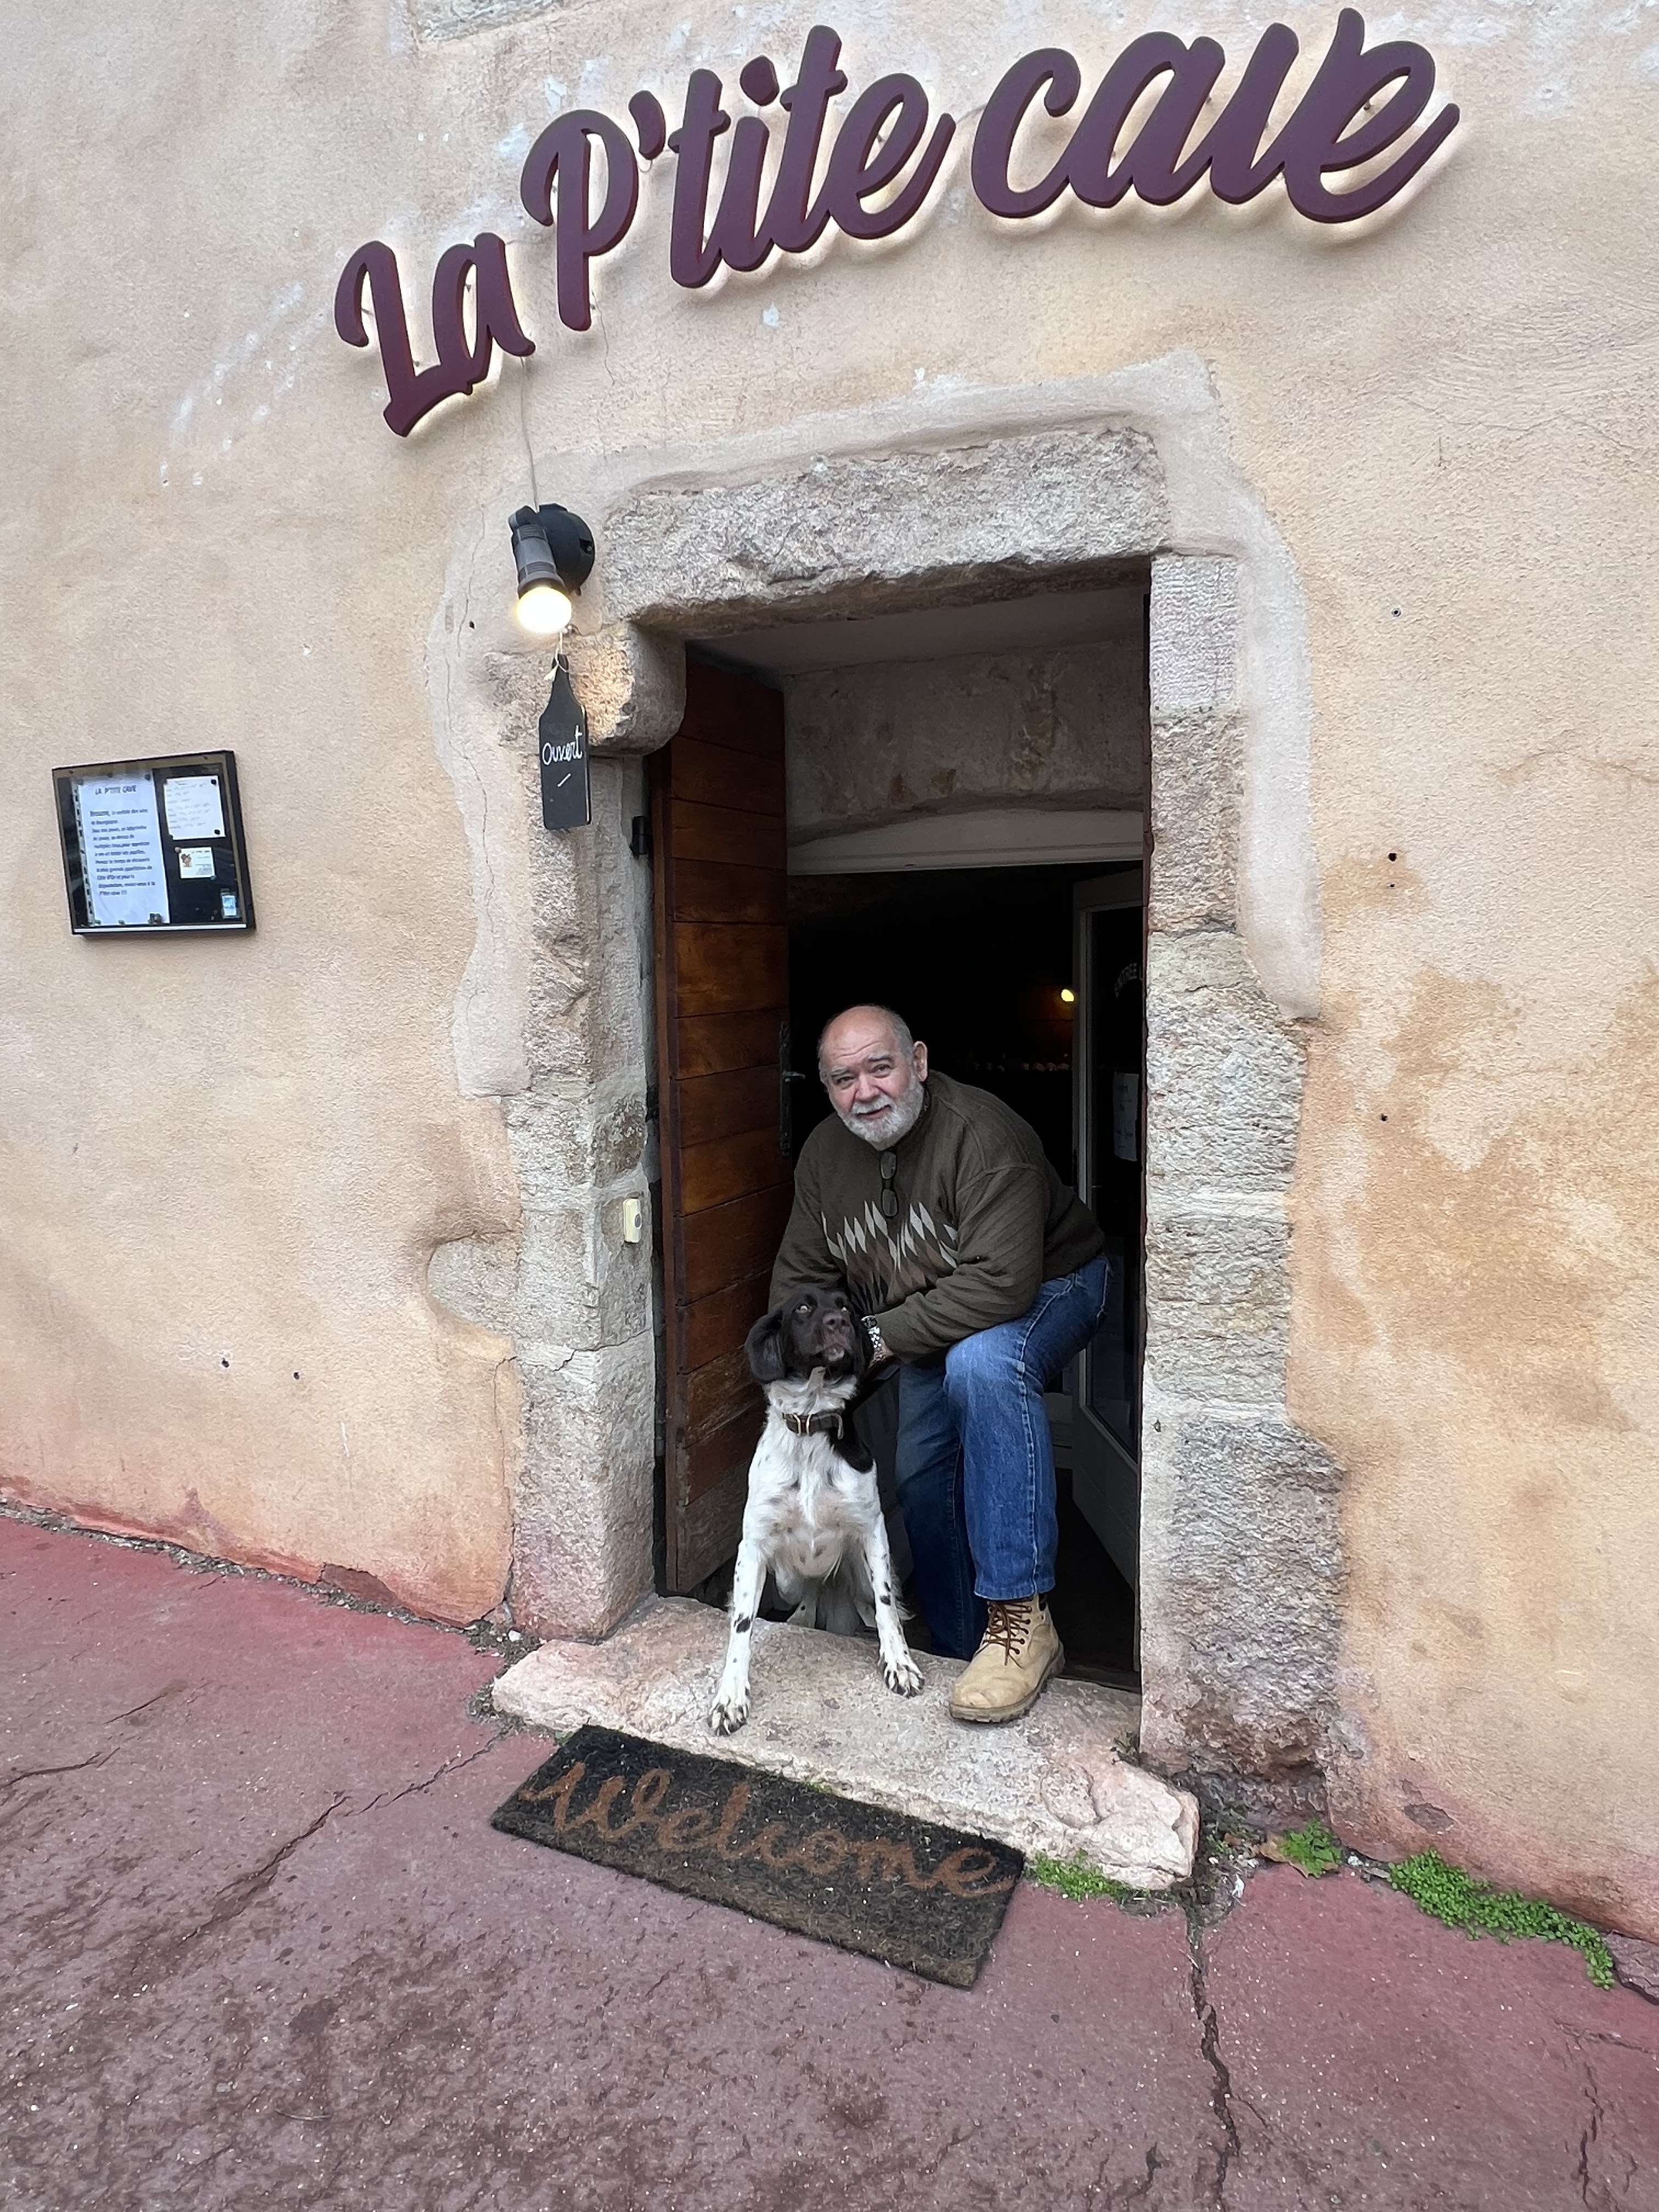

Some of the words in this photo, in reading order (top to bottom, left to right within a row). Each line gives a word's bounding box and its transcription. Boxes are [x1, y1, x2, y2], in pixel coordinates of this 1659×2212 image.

[334, 232, 535, 437] La
[520, 25, 956, 331] P'tite
[970, 7, 1460, 223] cave
[542, 724, 583, 765] Ouvert
[518, 1762, 1015, 1898] Welcome
